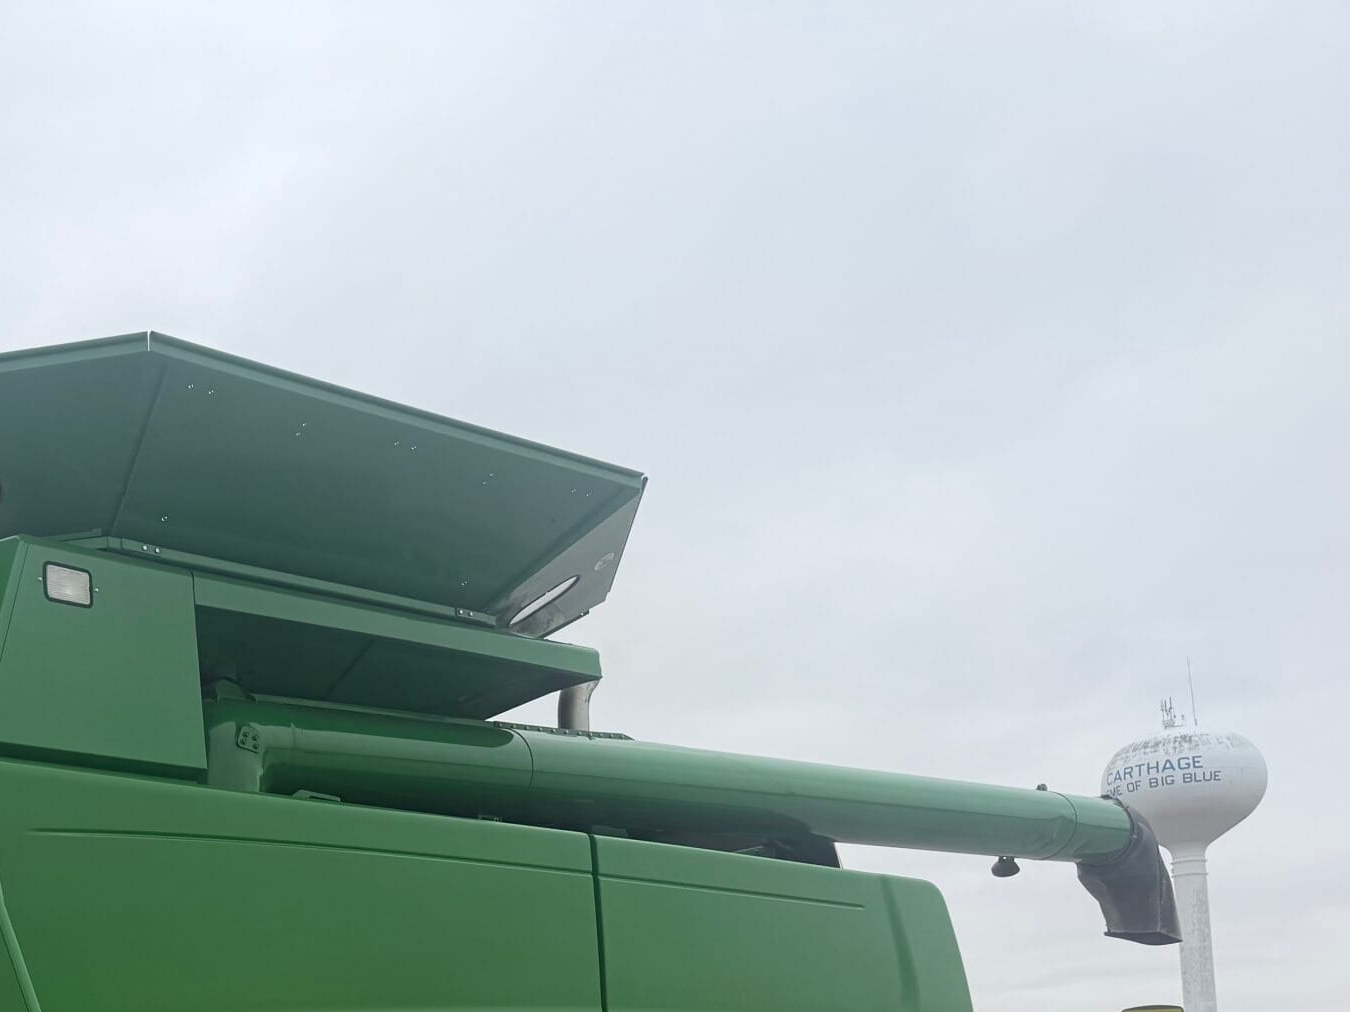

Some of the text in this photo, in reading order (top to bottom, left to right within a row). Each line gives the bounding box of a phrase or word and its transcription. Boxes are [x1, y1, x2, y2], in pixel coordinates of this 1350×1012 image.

[1107, 755, 1203, 786] CARTHAGE
[1127, 780, 1141, 793] OF
[1149, 775, 1175, 788] BIG
[1183, 770, 1222, 783] BLUE
